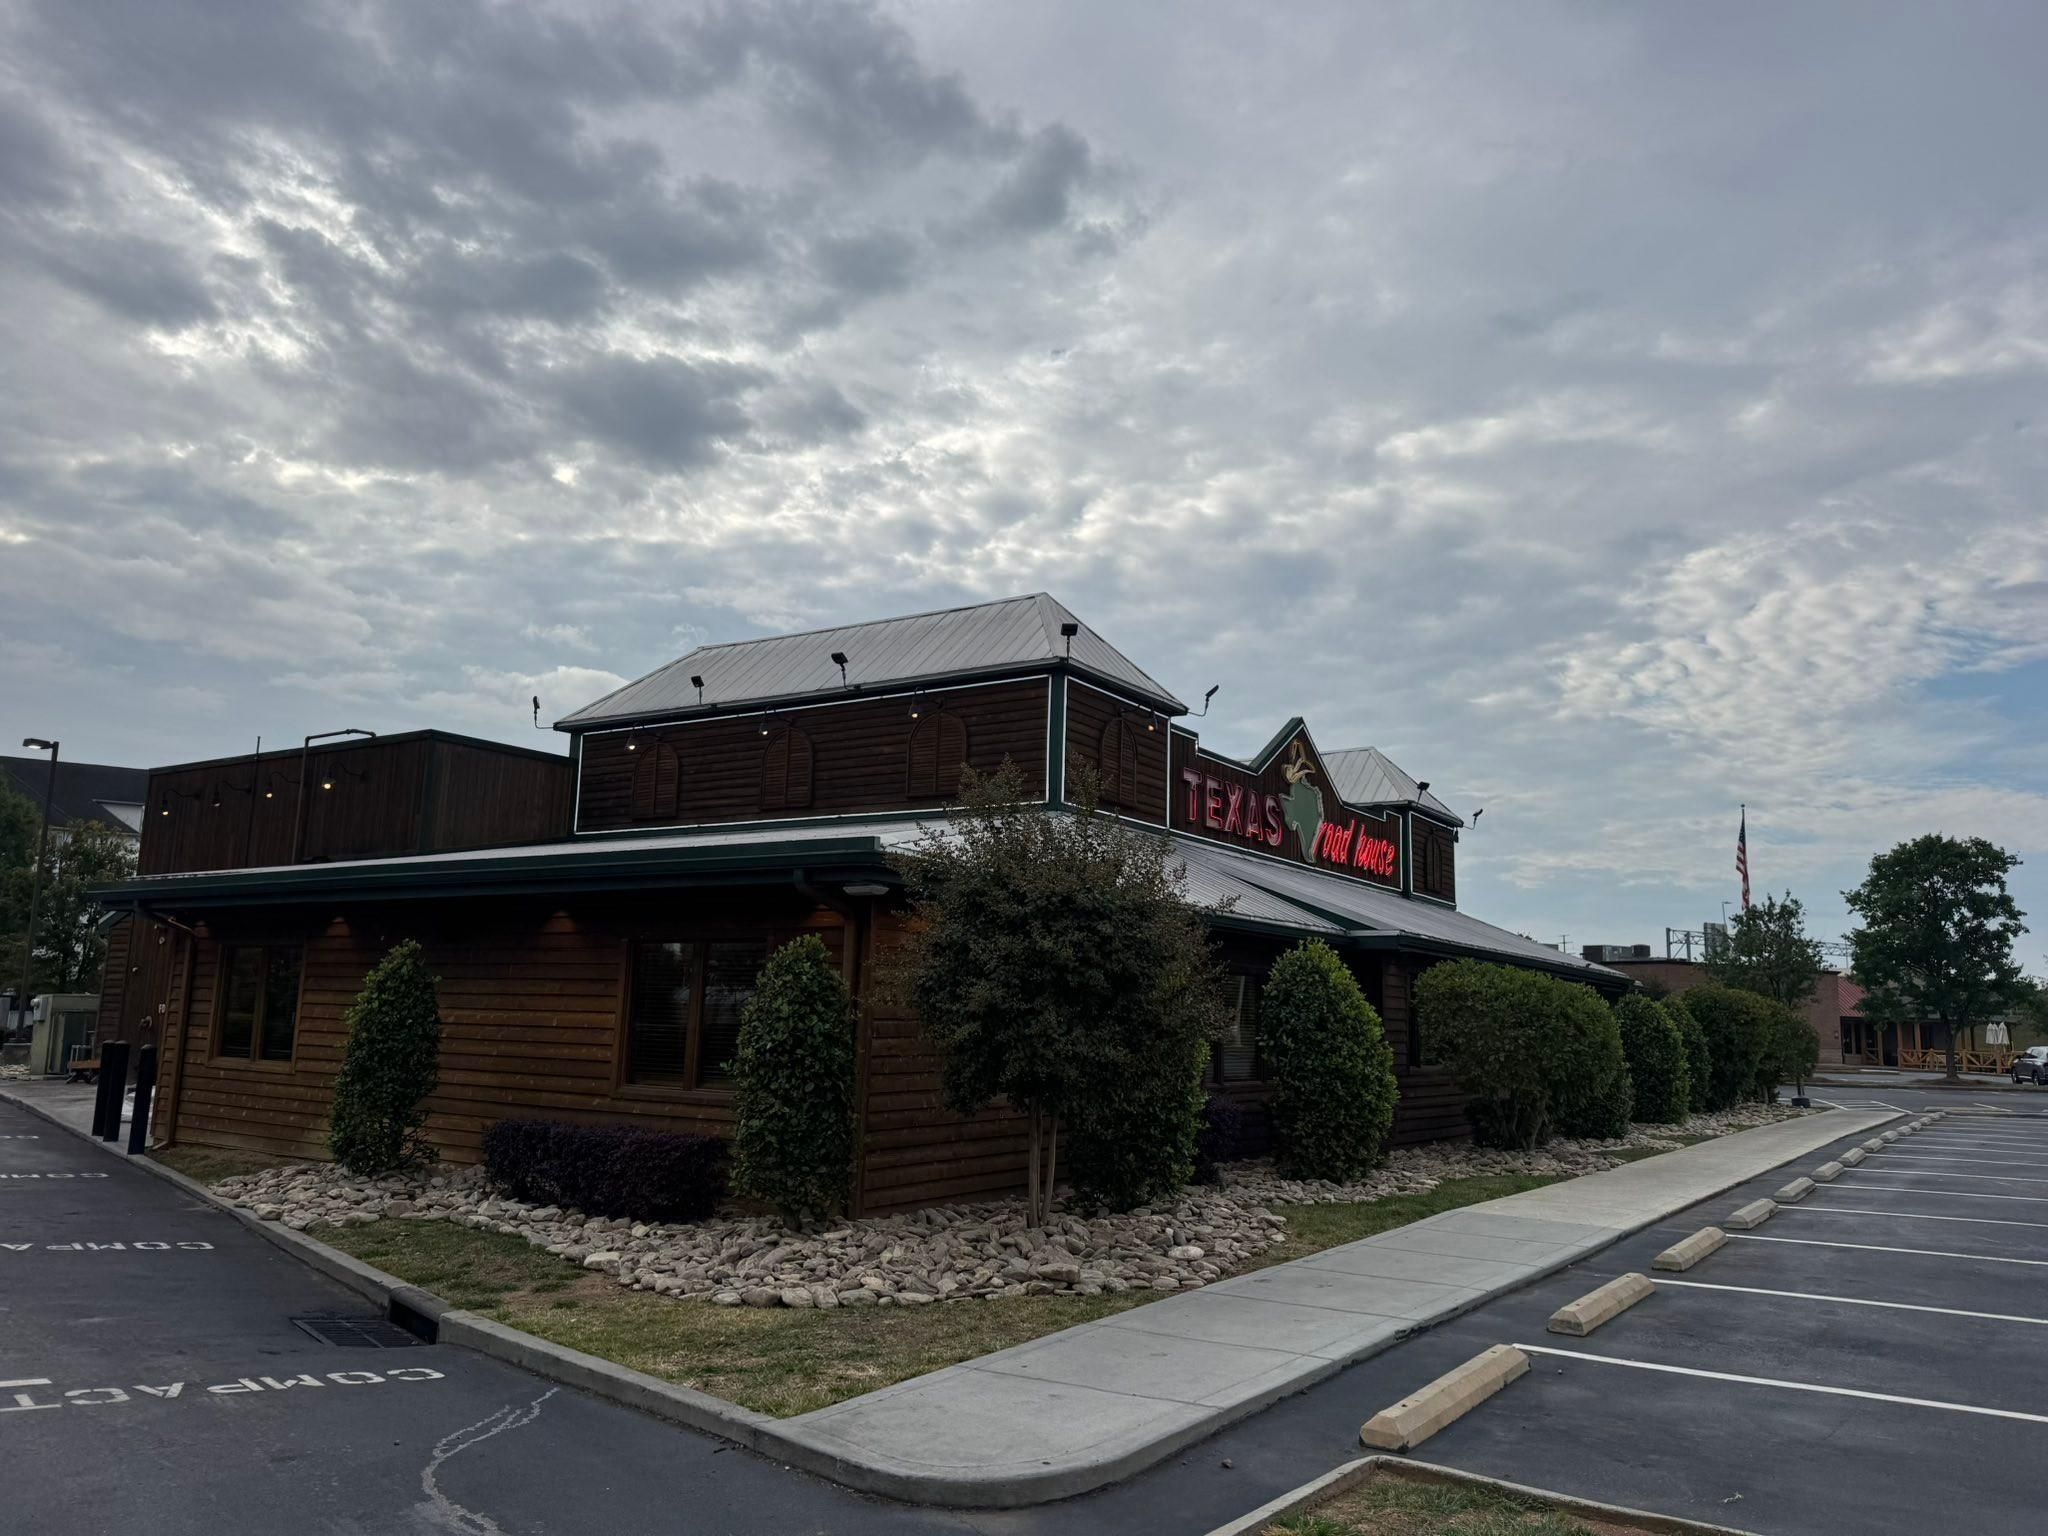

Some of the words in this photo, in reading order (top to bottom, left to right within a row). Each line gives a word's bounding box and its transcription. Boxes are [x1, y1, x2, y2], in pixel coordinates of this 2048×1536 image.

[1184, 767, 1283, 846] TEXAS
[1314, 819, 1356, 864] road
[1353, 824, 1396, 877] house
[0, 1367, 446, 1413] COMPACT
